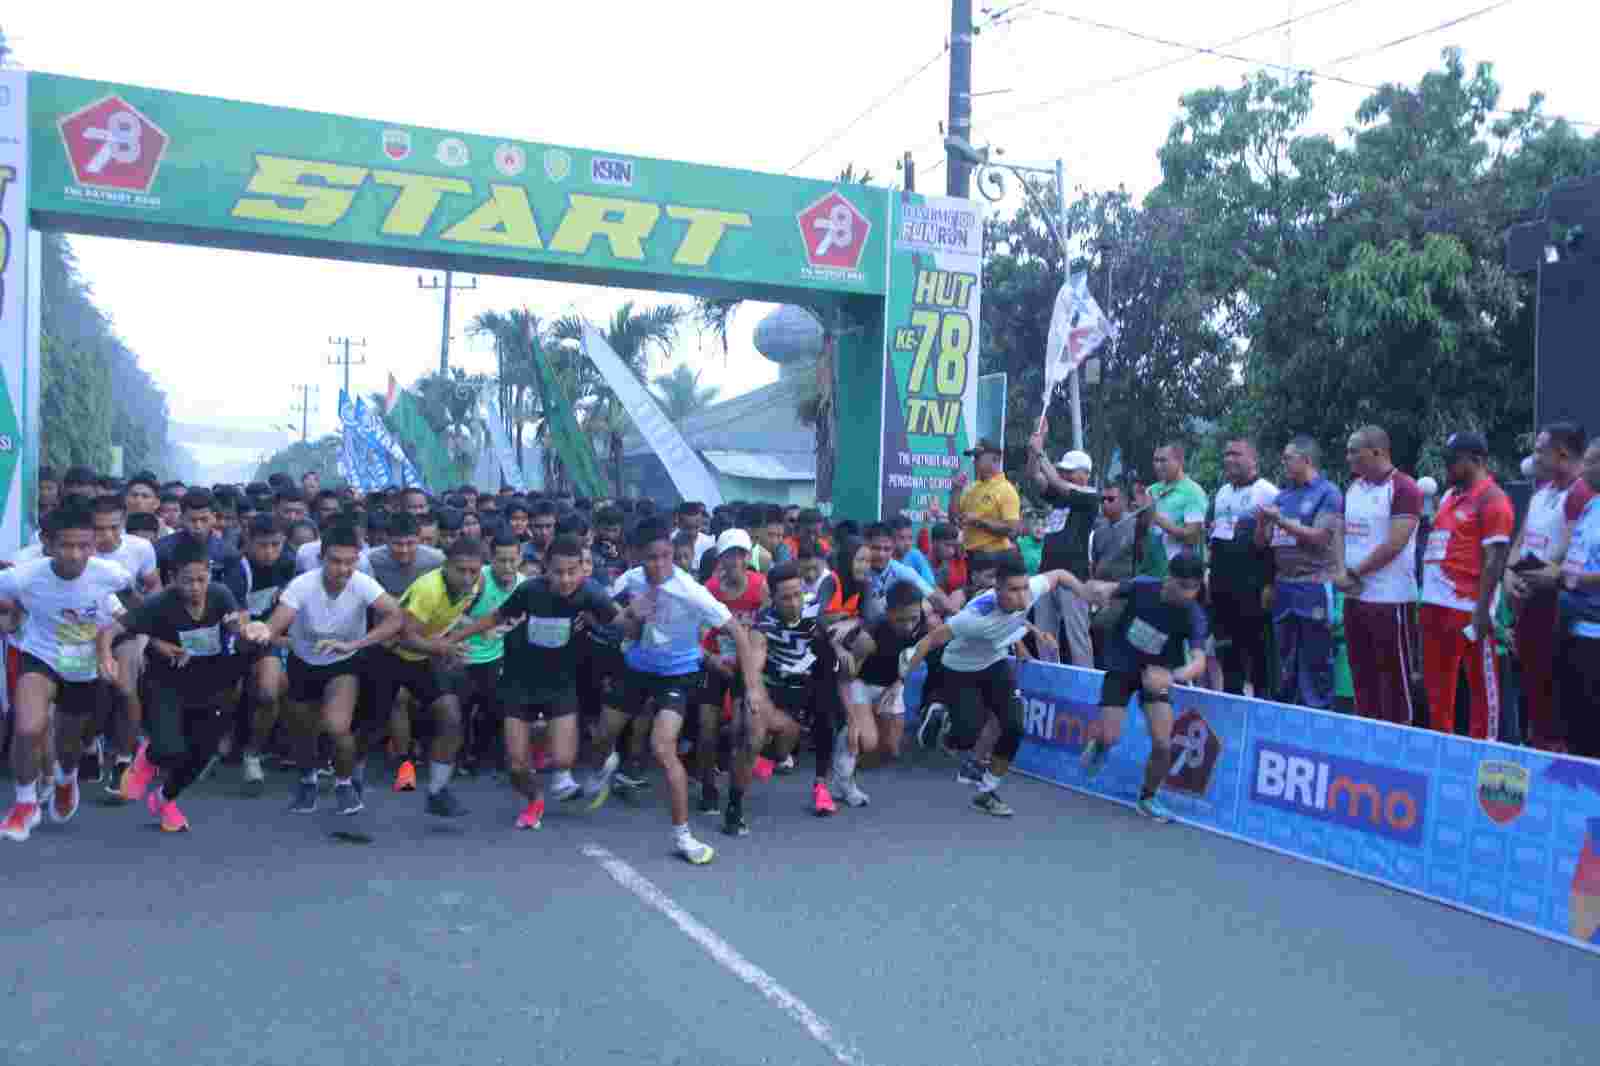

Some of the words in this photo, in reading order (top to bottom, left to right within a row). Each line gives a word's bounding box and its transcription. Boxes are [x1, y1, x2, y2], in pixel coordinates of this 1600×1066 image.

[82, 110, 141, 173] 78
[230, 153, 752, 266] START
[812, 203, 853, 256] 78
[913, 270, 977, 308] HUT
[908, 308, 973, 396] 78
[905, 397, 962, 436] TNI
[1256, 749, 1418, 831] BRImo
